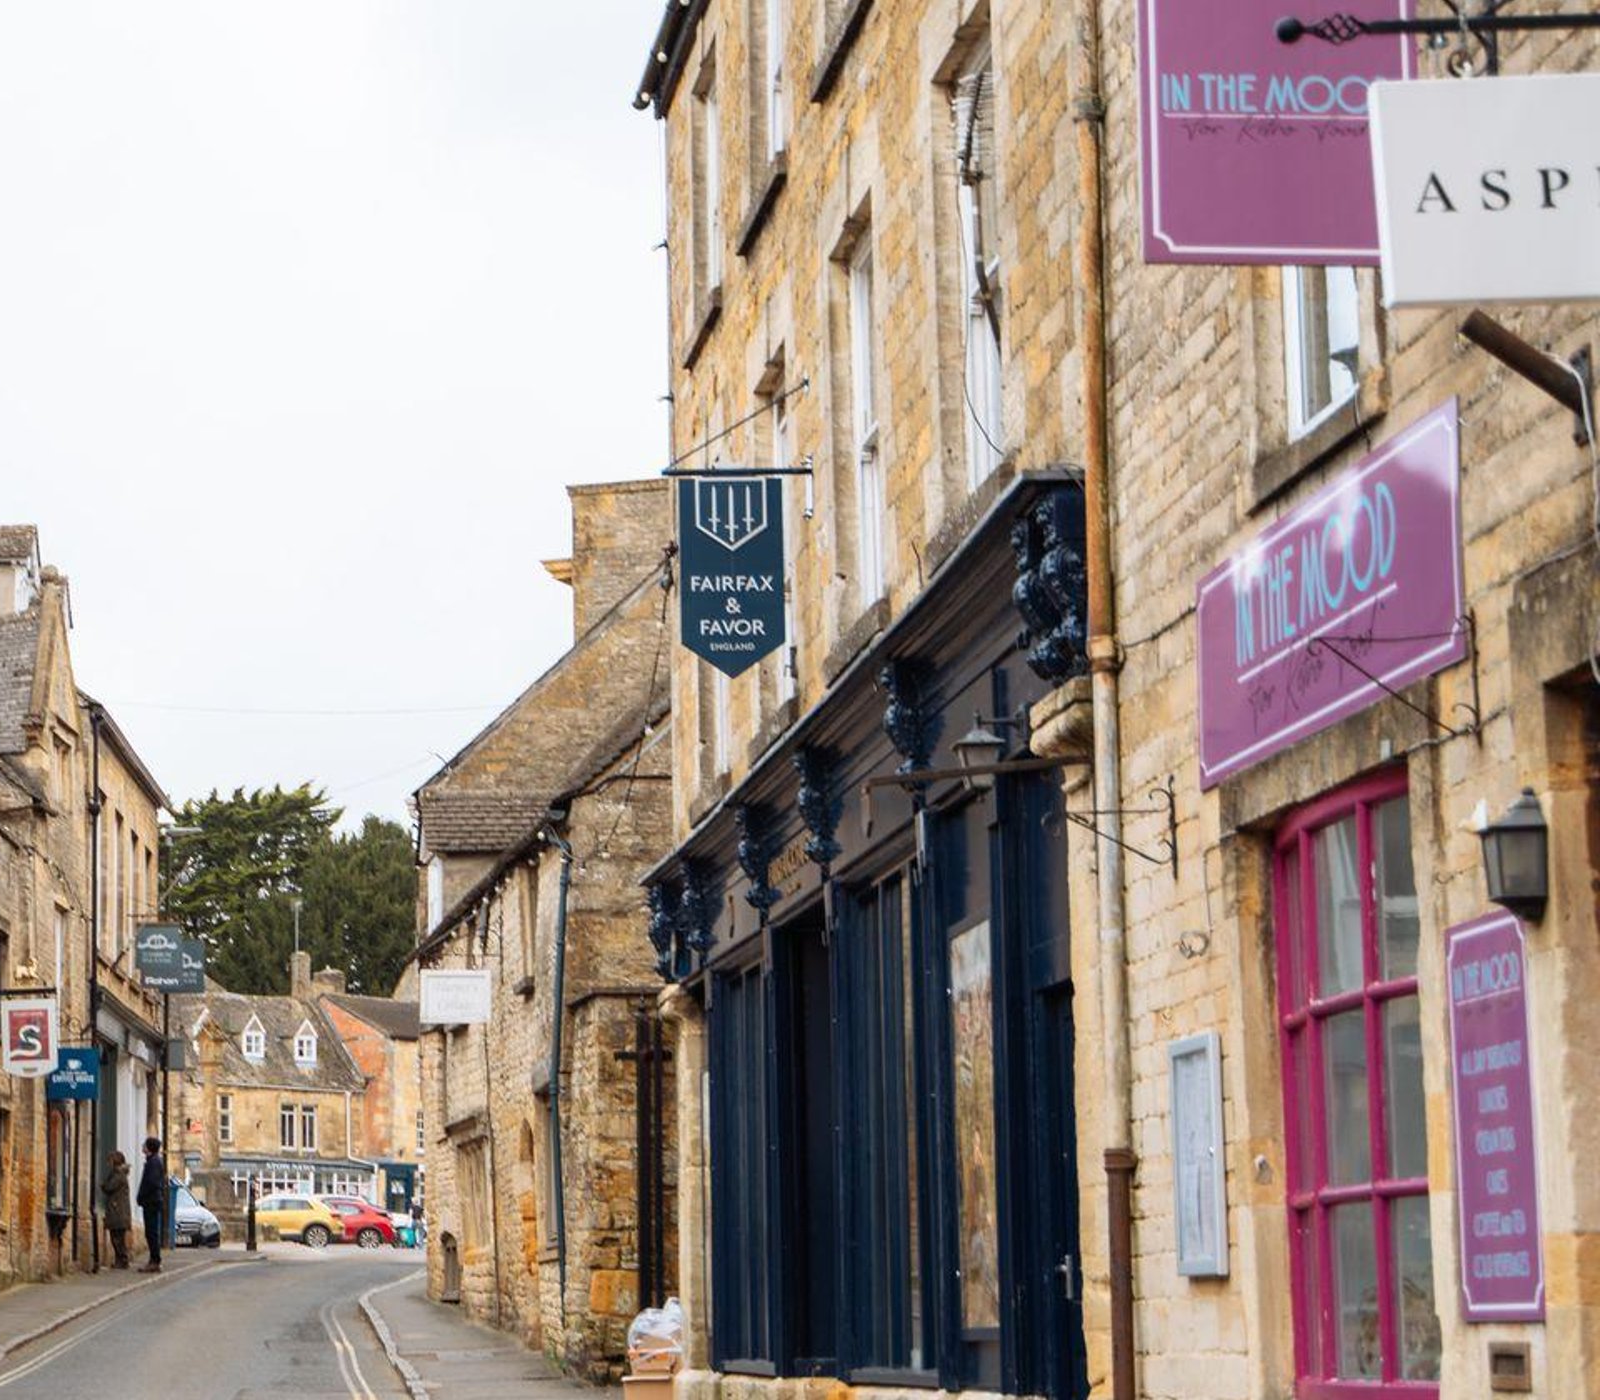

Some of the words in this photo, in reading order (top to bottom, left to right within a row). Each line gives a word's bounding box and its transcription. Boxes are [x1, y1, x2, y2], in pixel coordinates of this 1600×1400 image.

[1161, 73, 1191, 111] IN
[1198, 73, 1258, 112] THE
[1264, 74, 1373, 113] MOO
[1416, 166, 1600, 213] ASP
[1233, 566, 1256, 668] IN
[1258, 544, 1295, 652] THE
[1299, 481, 1397, 628] MOOD
[691, 575, 774, 592] FAIRFAX
[725, 597, 741, 613] &
[700, 619, 765, 636] FAVOR
[710, 643, 755, 652] ENGLAND
